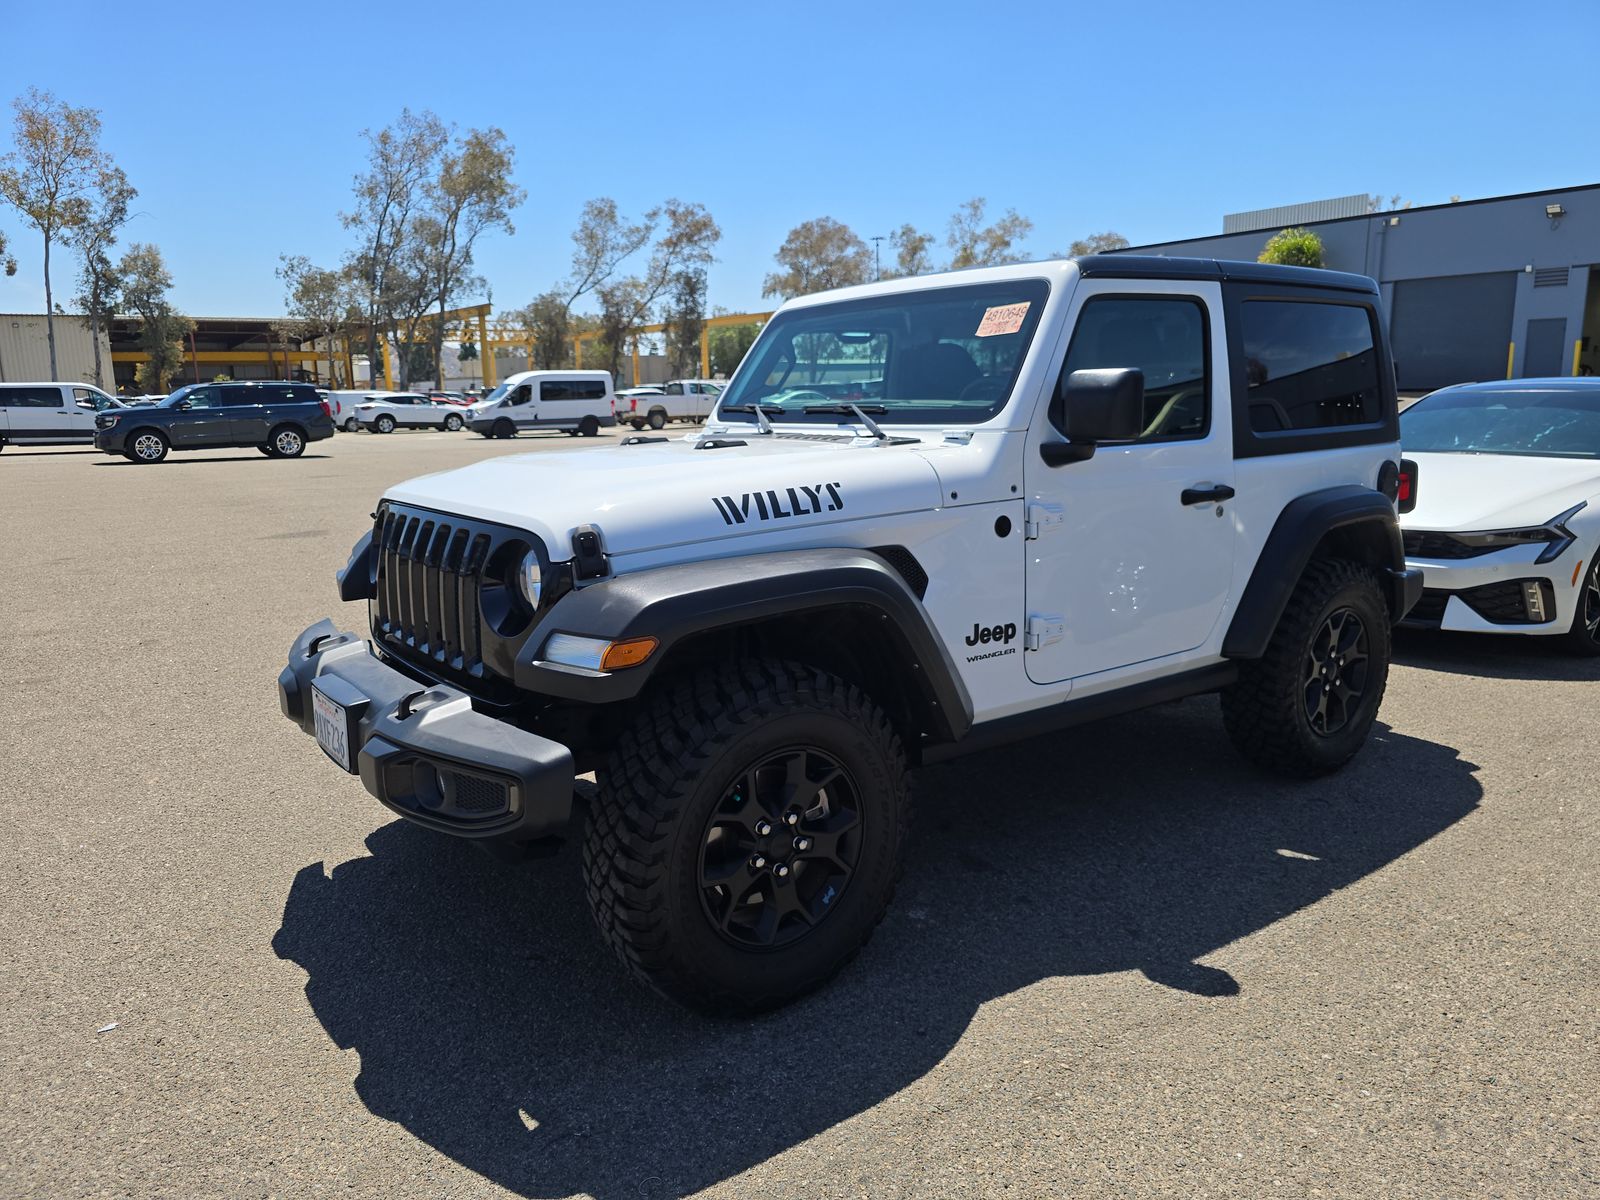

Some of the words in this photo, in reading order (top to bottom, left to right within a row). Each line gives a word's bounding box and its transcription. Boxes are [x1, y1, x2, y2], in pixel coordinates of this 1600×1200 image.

[711, 482, 844, 525] WILLYS
[965, 622, 1017, 646] Jeep
[966, 648, 1016, 663] WRANGLER
